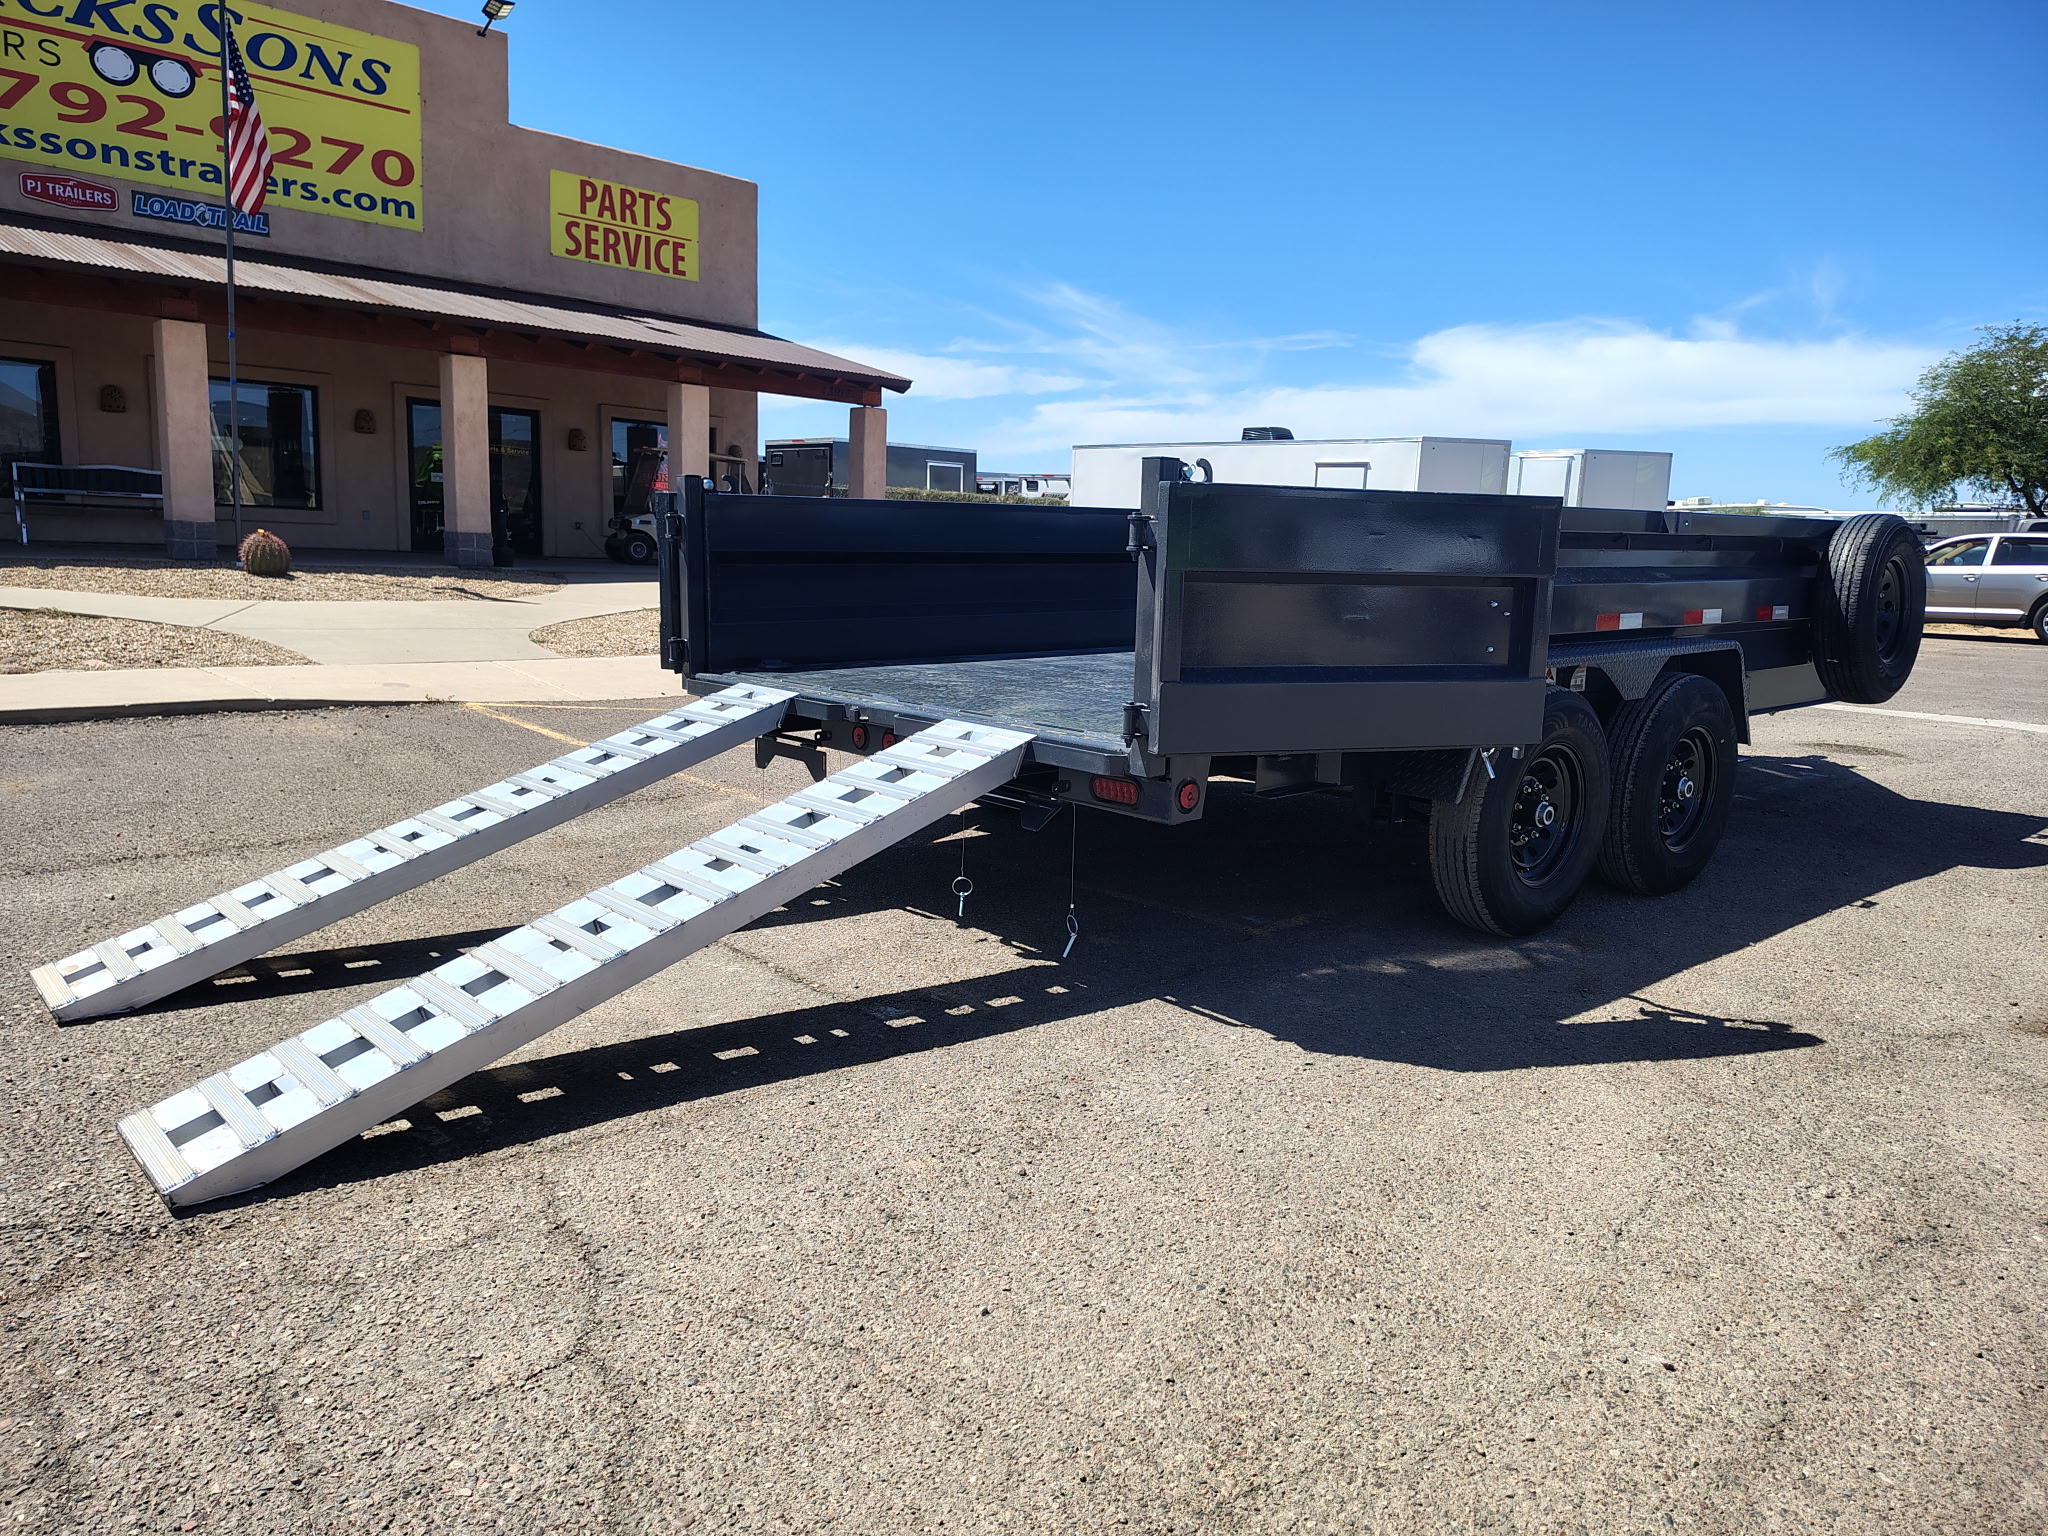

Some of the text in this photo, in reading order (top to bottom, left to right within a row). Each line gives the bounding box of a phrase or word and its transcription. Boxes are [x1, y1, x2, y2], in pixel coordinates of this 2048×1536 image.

[26, 180, 112, 205] PJ TRAILERS
[134, 194, 197, 221] LOAD
[580, 179, 672, 231] PARTS
[565, 221, 686, 277] SERVICE
